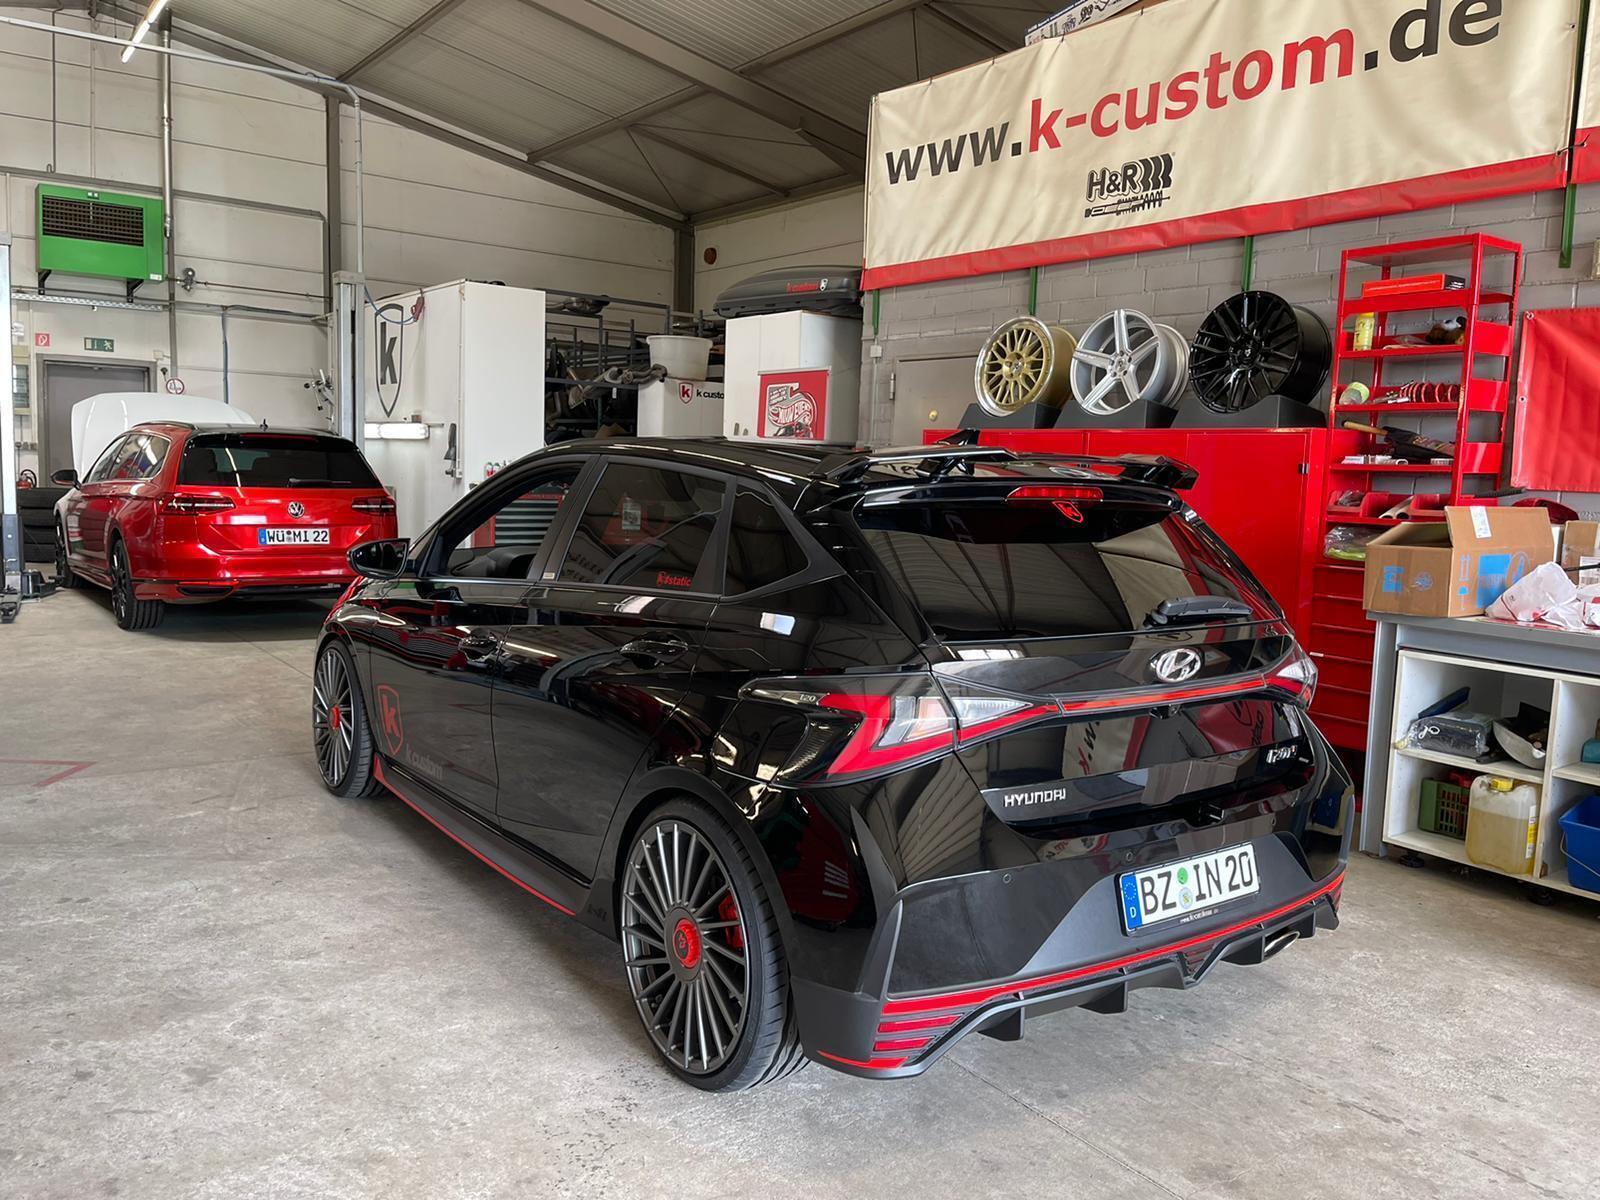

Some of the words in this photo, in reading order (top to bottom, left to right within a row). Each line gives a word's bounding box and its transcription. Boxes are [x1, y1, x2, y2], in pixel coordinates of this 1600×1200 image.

[885, 0, 1501, 185] www.k-custom.de
[1087, 160, 1142, 202] H&R
[380, 321, 398, 385] k
[267, 530, 285, 543] WÜ
[293, 531, 310, 543] MI
[313, 530, 329, 543] 22
[1004, 788, 1066, 807] HYUNDAI
[1129, 906, 1137, 919] D
[1140, 870, 1177, 916] BZ
[1193, 858, 1223, 902] IN
[1225, 851, 1254, 893] 20
